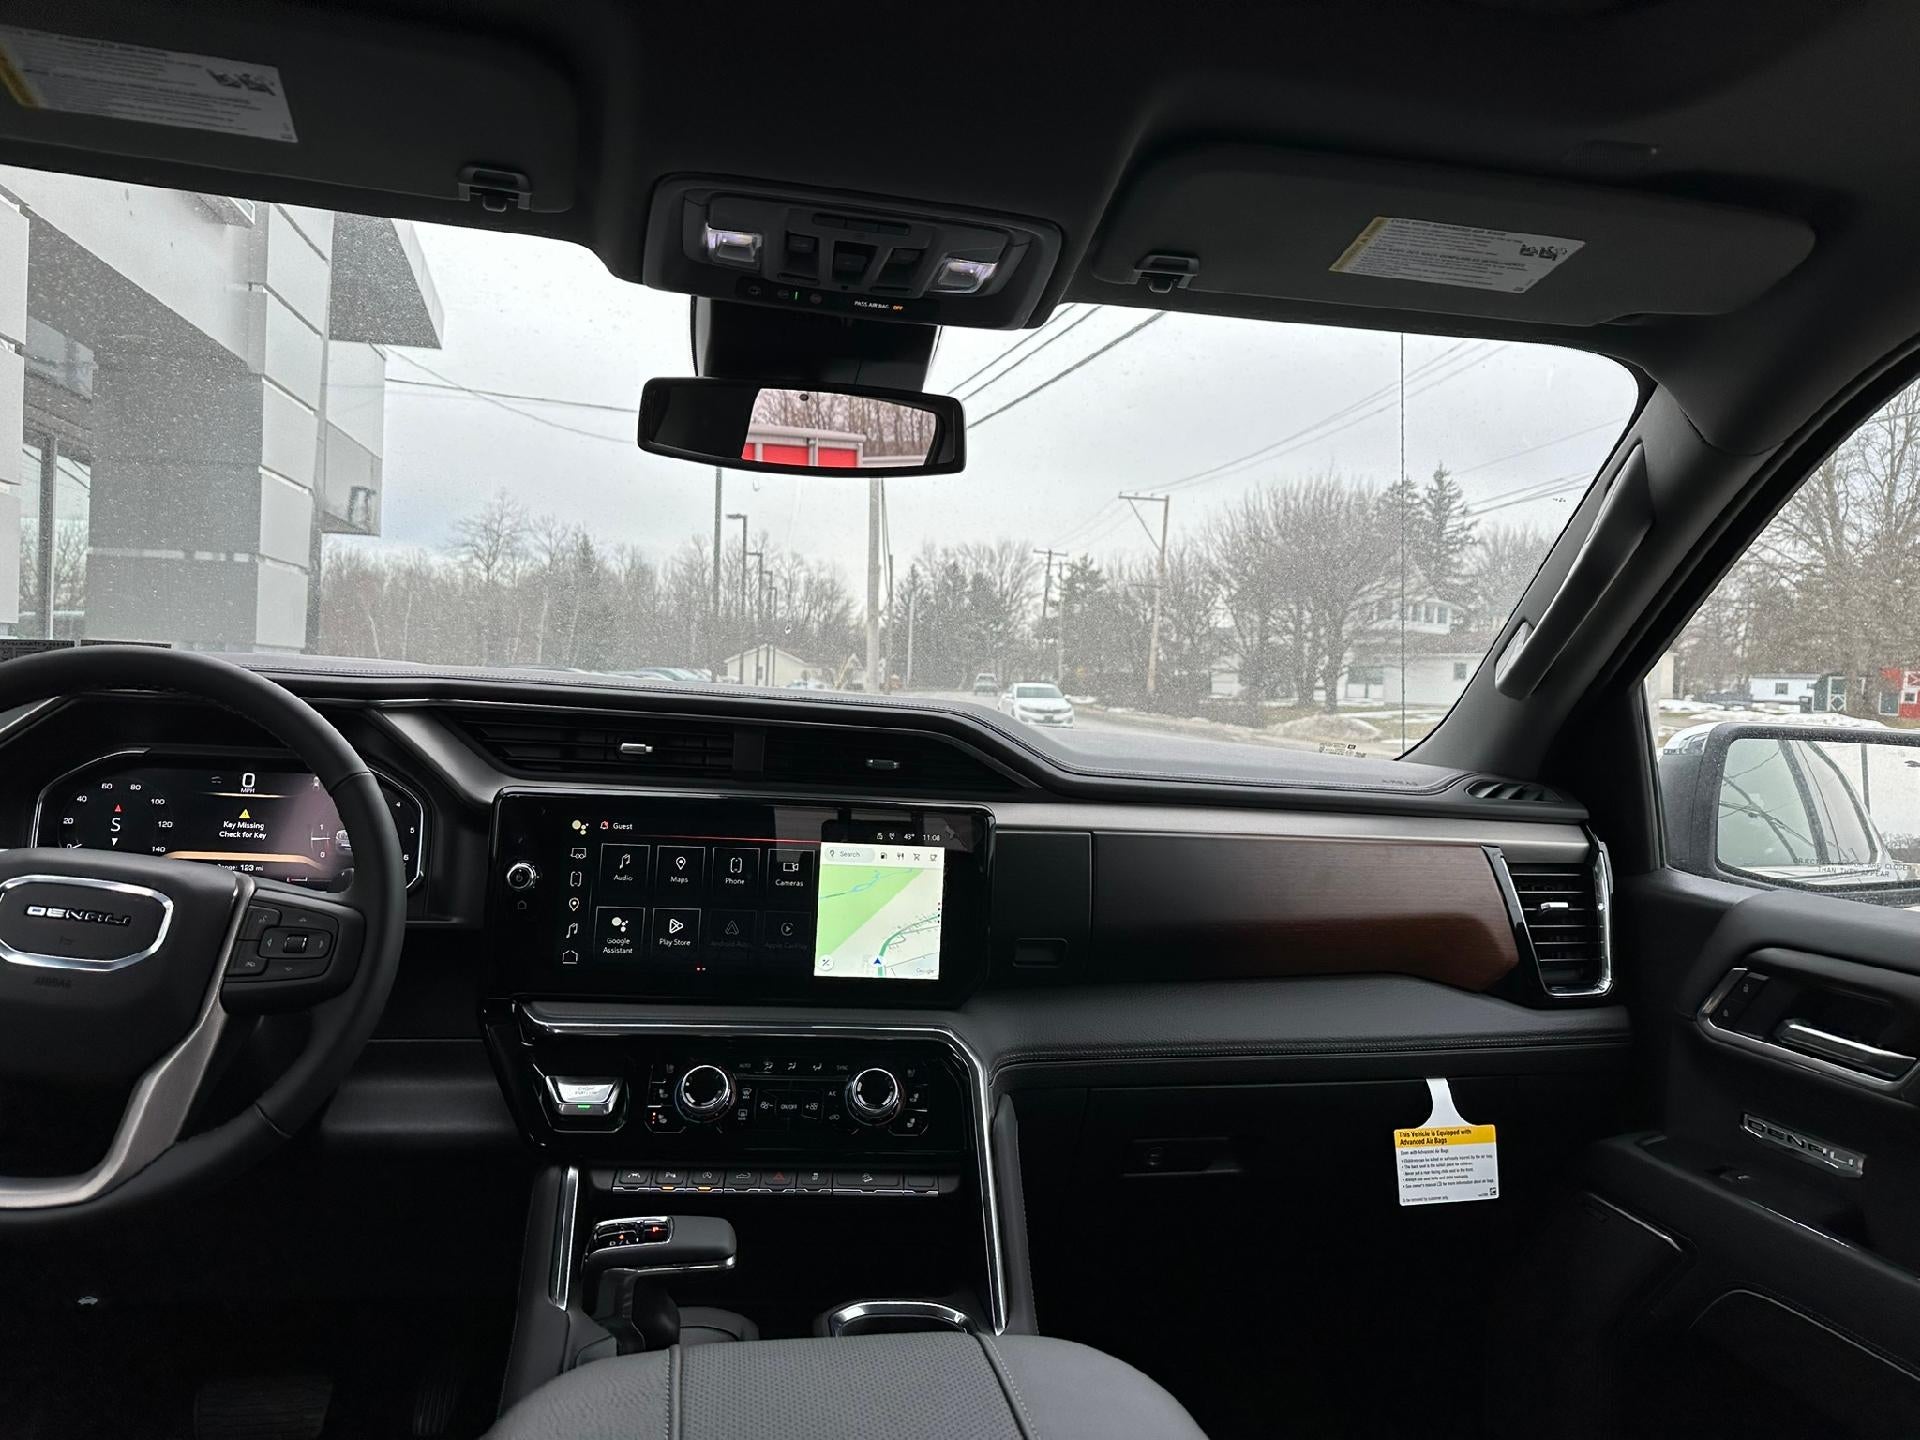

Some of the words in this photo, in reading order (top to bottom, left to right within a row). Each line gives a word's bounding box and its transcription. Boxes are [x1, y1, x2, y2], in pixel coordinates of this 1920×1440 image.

[242, 772, 255, 788] 0
[76, 795, 87, 803] 40
[111, 817, 121, 832] S
[223, 821, 236, 830] Key
[237, 822, 264, 831] Missing
[612, 822, 633, 830] Guest
[242, 831, 253, 839] for
[254, 832, 266, 840] Key
[670, 876, 689, 884] Maps
[725, 877, 745, 885] Phone
[775, 878, 804, 887] Cameras
[27, 905, 130, 926] DENALI
[606, 938, 630, 946] Google
[659, 938, 672, 947] Play
[603, 946, 633, 954] Assistant
[1399, 1137, 1424, 1145] Advanced
[1433, 1136, 1447, 1144] Bags
